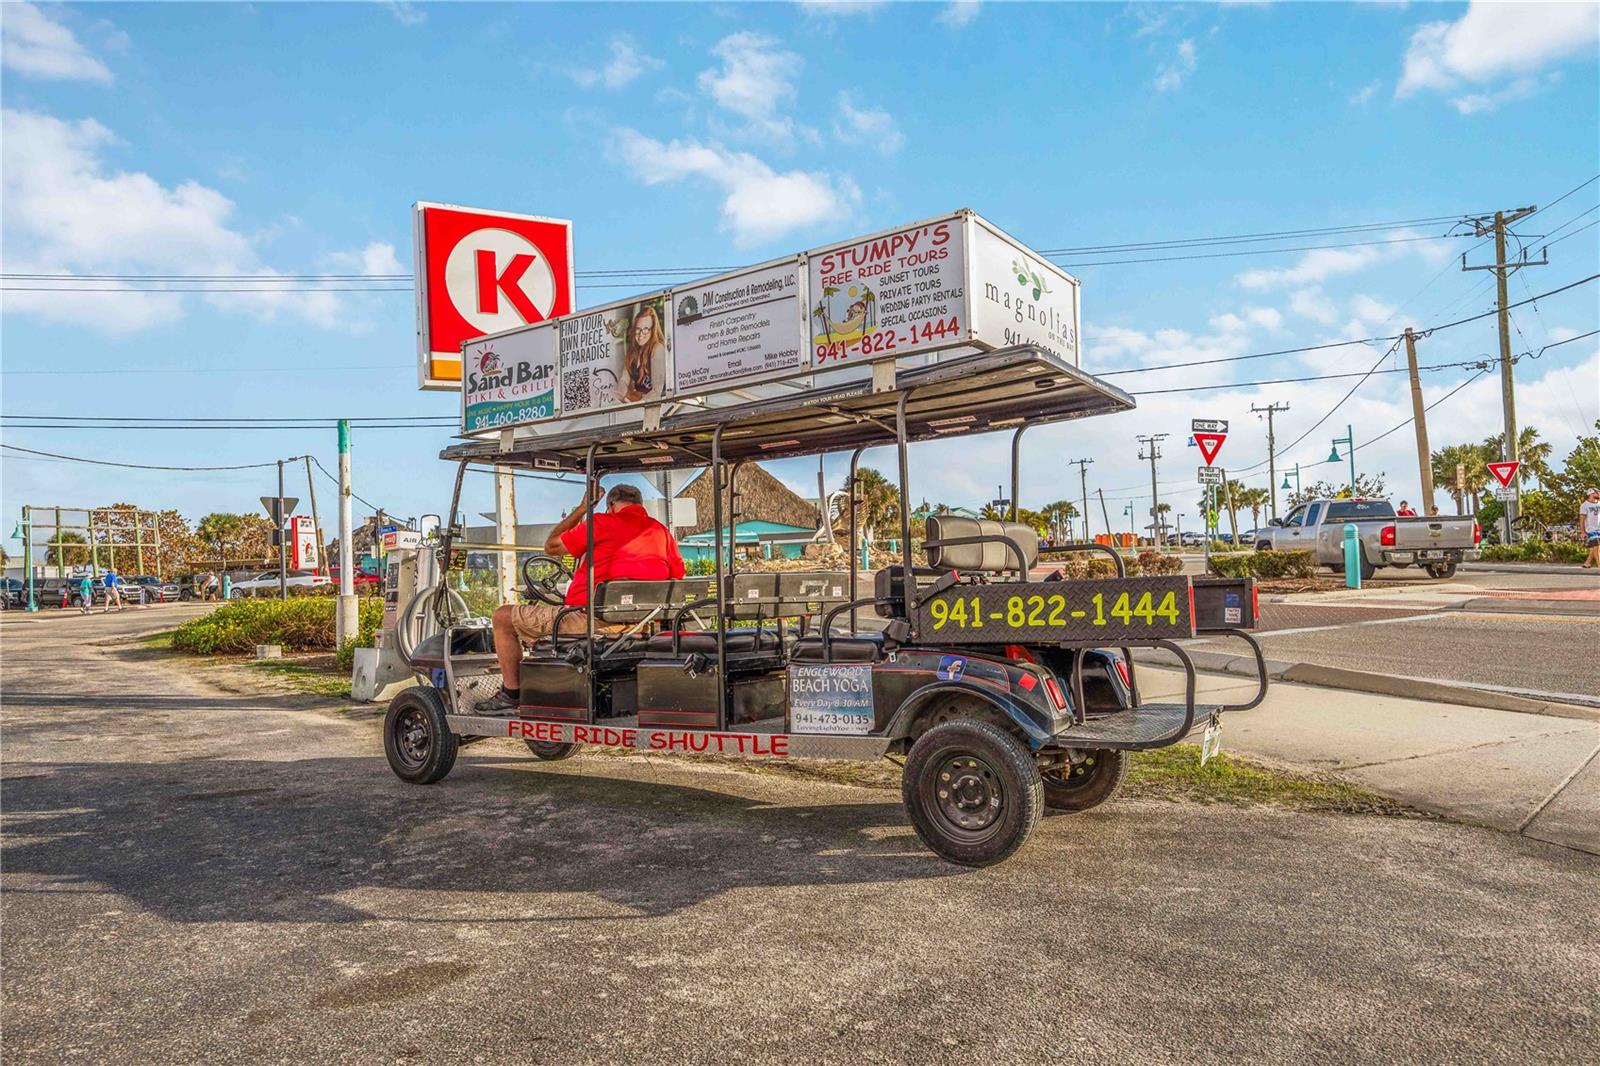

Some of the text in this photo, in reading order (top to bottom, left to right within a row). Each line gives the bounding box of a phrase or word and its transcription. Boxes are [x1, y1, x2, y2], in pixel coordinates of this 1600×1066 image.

[820, 225, 950, 274] STUMPY'S
[821, 247, 949, 288] FREE RIDE TOURS
[880, 264, 940, 287] SUNSET TOURS
[475, 249, 546, 324] K
[702, 290, 714, 307] DM
[715, 287, 745, 304] Construction
[880, 279, 941, 300] PRIVATE TOURS
[880, 288, 963, 314] WEDDING PARTY RENTALS
[985, 282, 1074, 343] magnolias
[561, 313, 603, 338] FIND YOUR
[726, 312, 757, 325] Carpentry
[880, 305, 948, 328] SPECIAL OCCASIONS
[561, 329, 603, 353] OWN PIECE
[707, 332, 761, 350] and Home Repairs
[816, 316, 960, 365] 941-822-1444
[561, 343, 610, 368] OF PARADISE
[727, 360, 742, 369] Email
[764, 349, 799, 361] Mike Hobby
[468, 361, 554, 394] Sand Bar
[678, 367, 710, 380] Doug McCoy
[467, 391, 492, 404] TIKI
[497, 388, 506, 400] &
[475, 405, 546, 429] 941-460-8280
[930, 591, 1180, 630] 941-822-1444
[798, 667, 864, 677] ENGLEWOOD
[792, 678, 869, 693] BEACH YOGA
[794, 699, 815, 708] Every
[816, 699, 832, 709] Day
[854, 699, 868, 707] AM
[795, 713, 870, 725] 941-473-0135
[508, 720, 789, 756] FREE RIDE SHUTTLE
